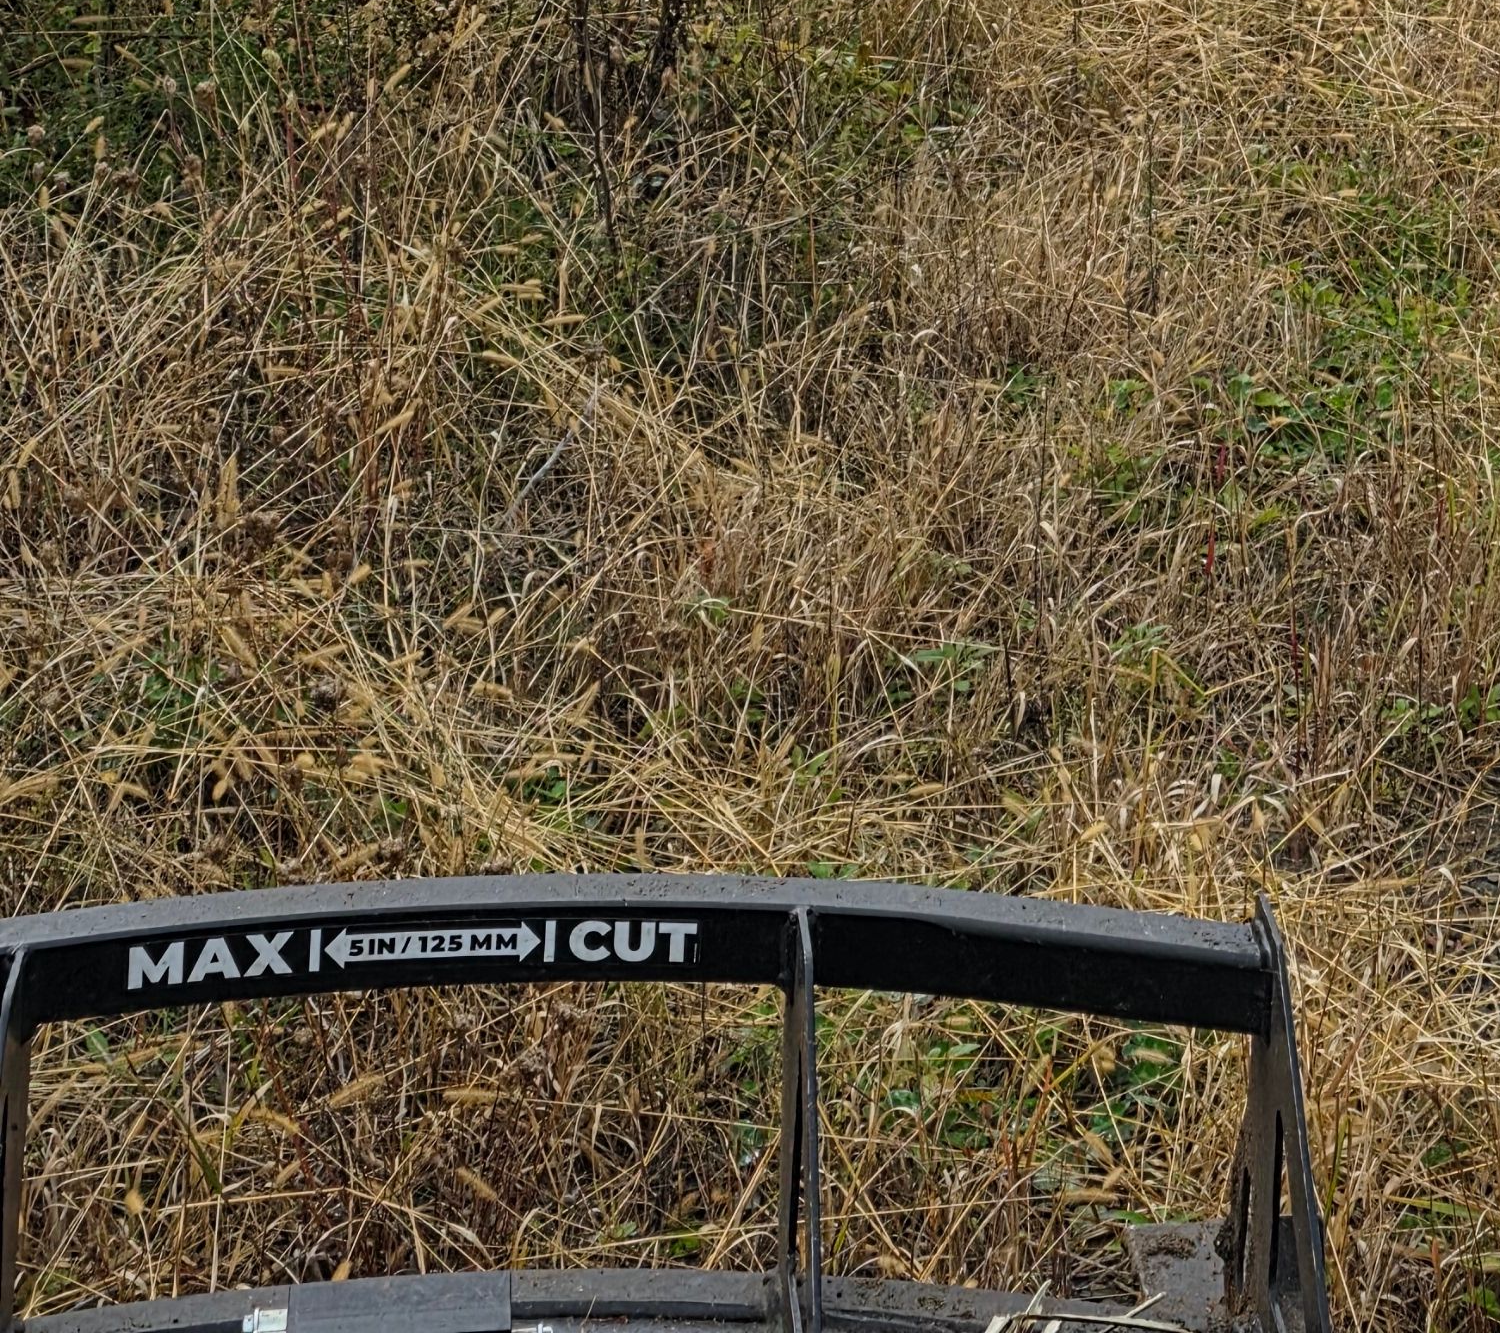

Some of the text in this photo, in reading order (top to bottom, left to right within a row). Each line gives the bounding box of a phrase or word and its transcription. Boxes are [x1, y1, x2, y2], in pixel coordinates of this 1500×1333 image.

[126, 931, 295, 991] MAX
[417, 935, 463, 954] 125
[469, 933, 519, 953] MM
[569, 920, 698, 963] CUT
